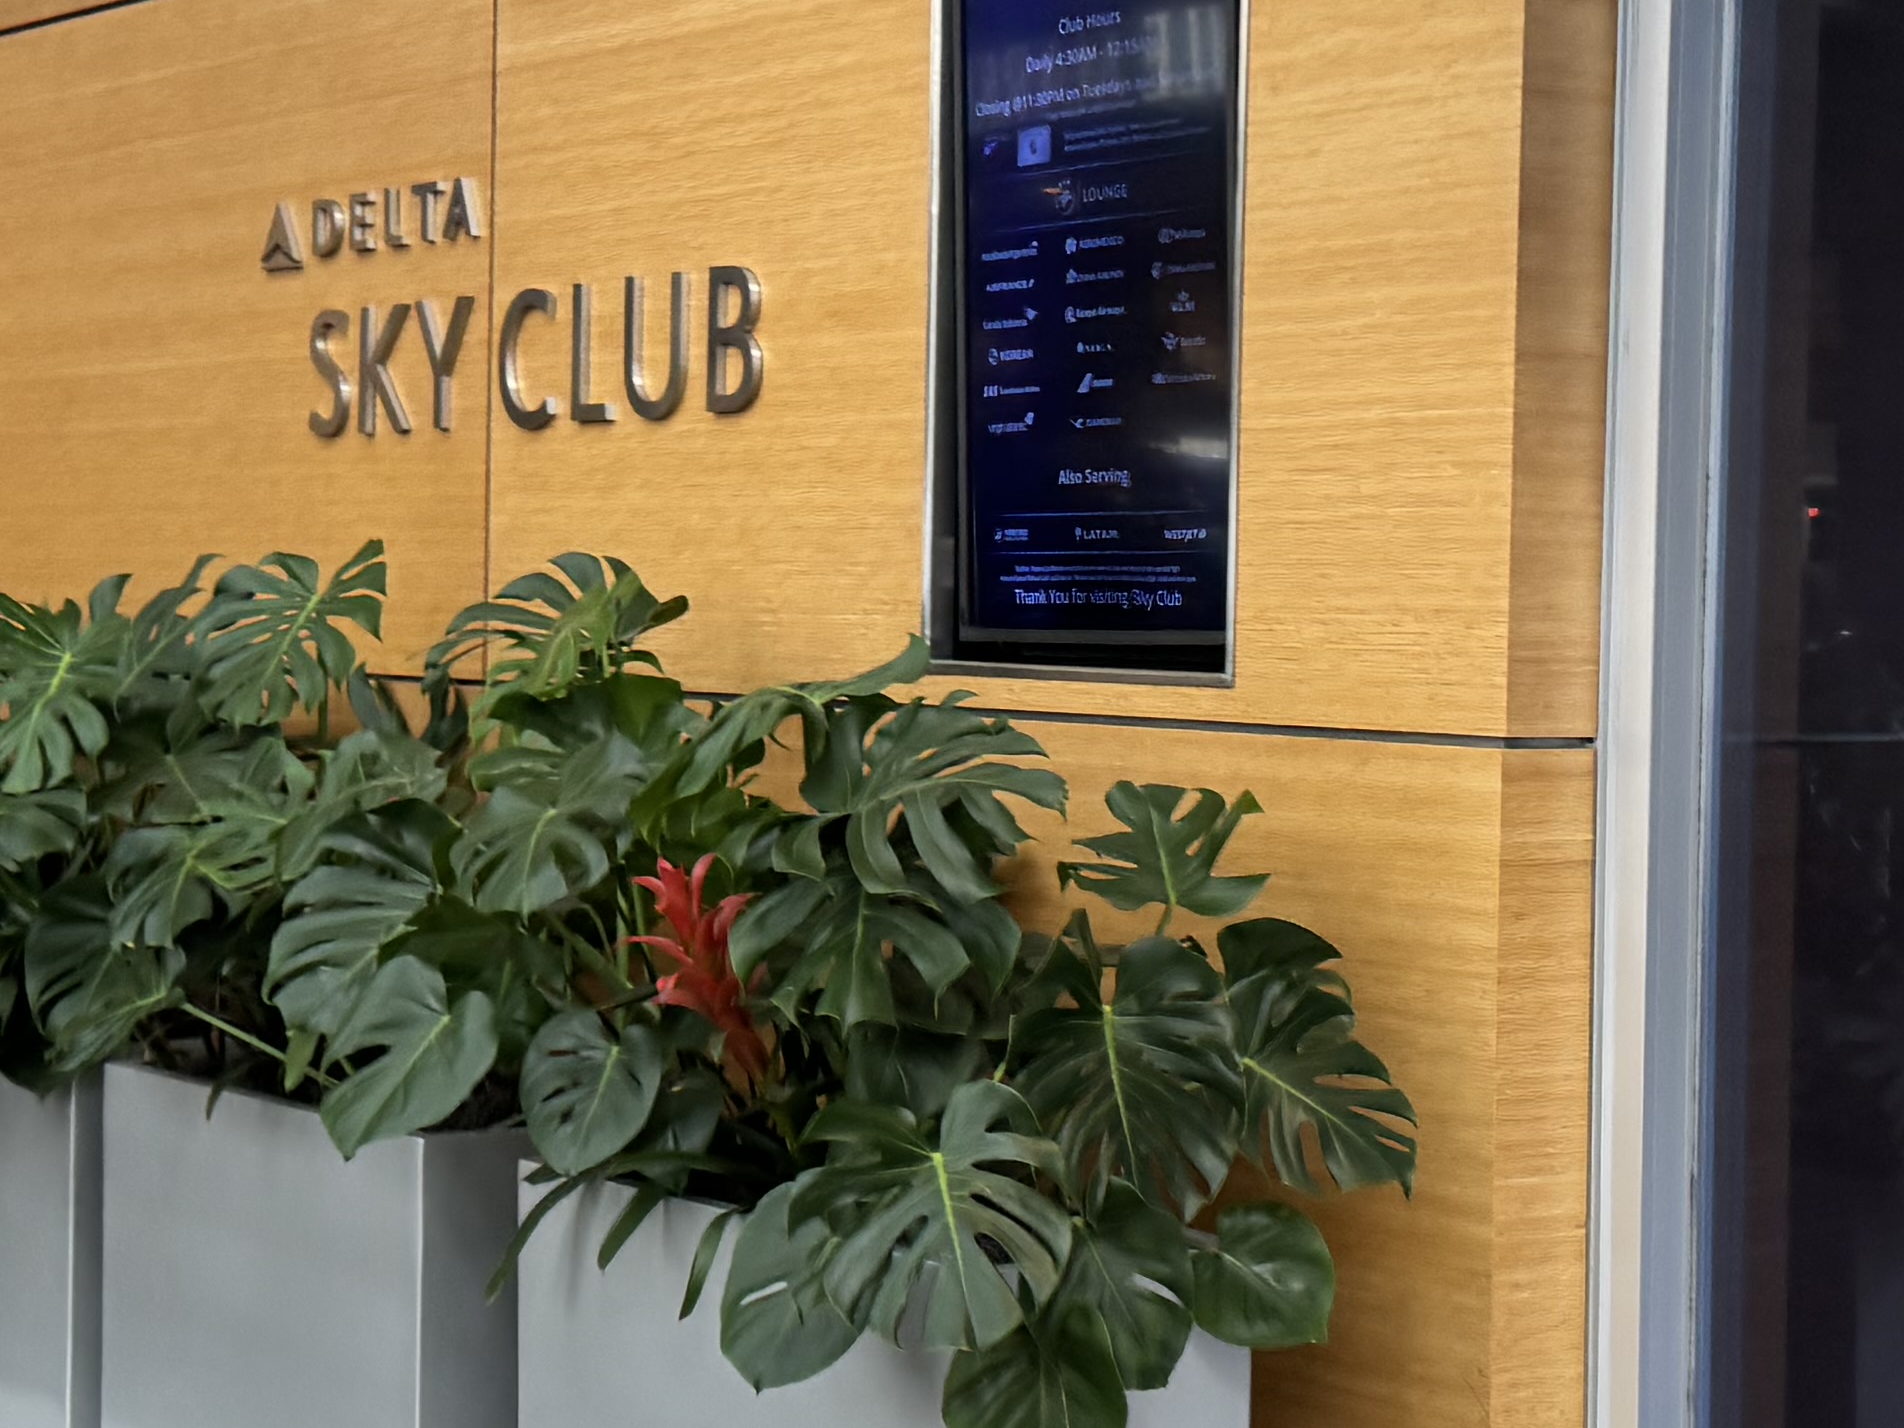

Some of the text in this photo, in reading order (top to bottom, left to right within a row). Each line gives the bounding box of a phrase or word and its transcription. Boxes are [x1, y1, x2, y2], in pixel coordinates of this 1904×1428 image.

[1059, 11, 1121, 35] Club Hours
[311, 177, 482, 258] DELTA
[307, 264, 764, 439] SKY CLUB
